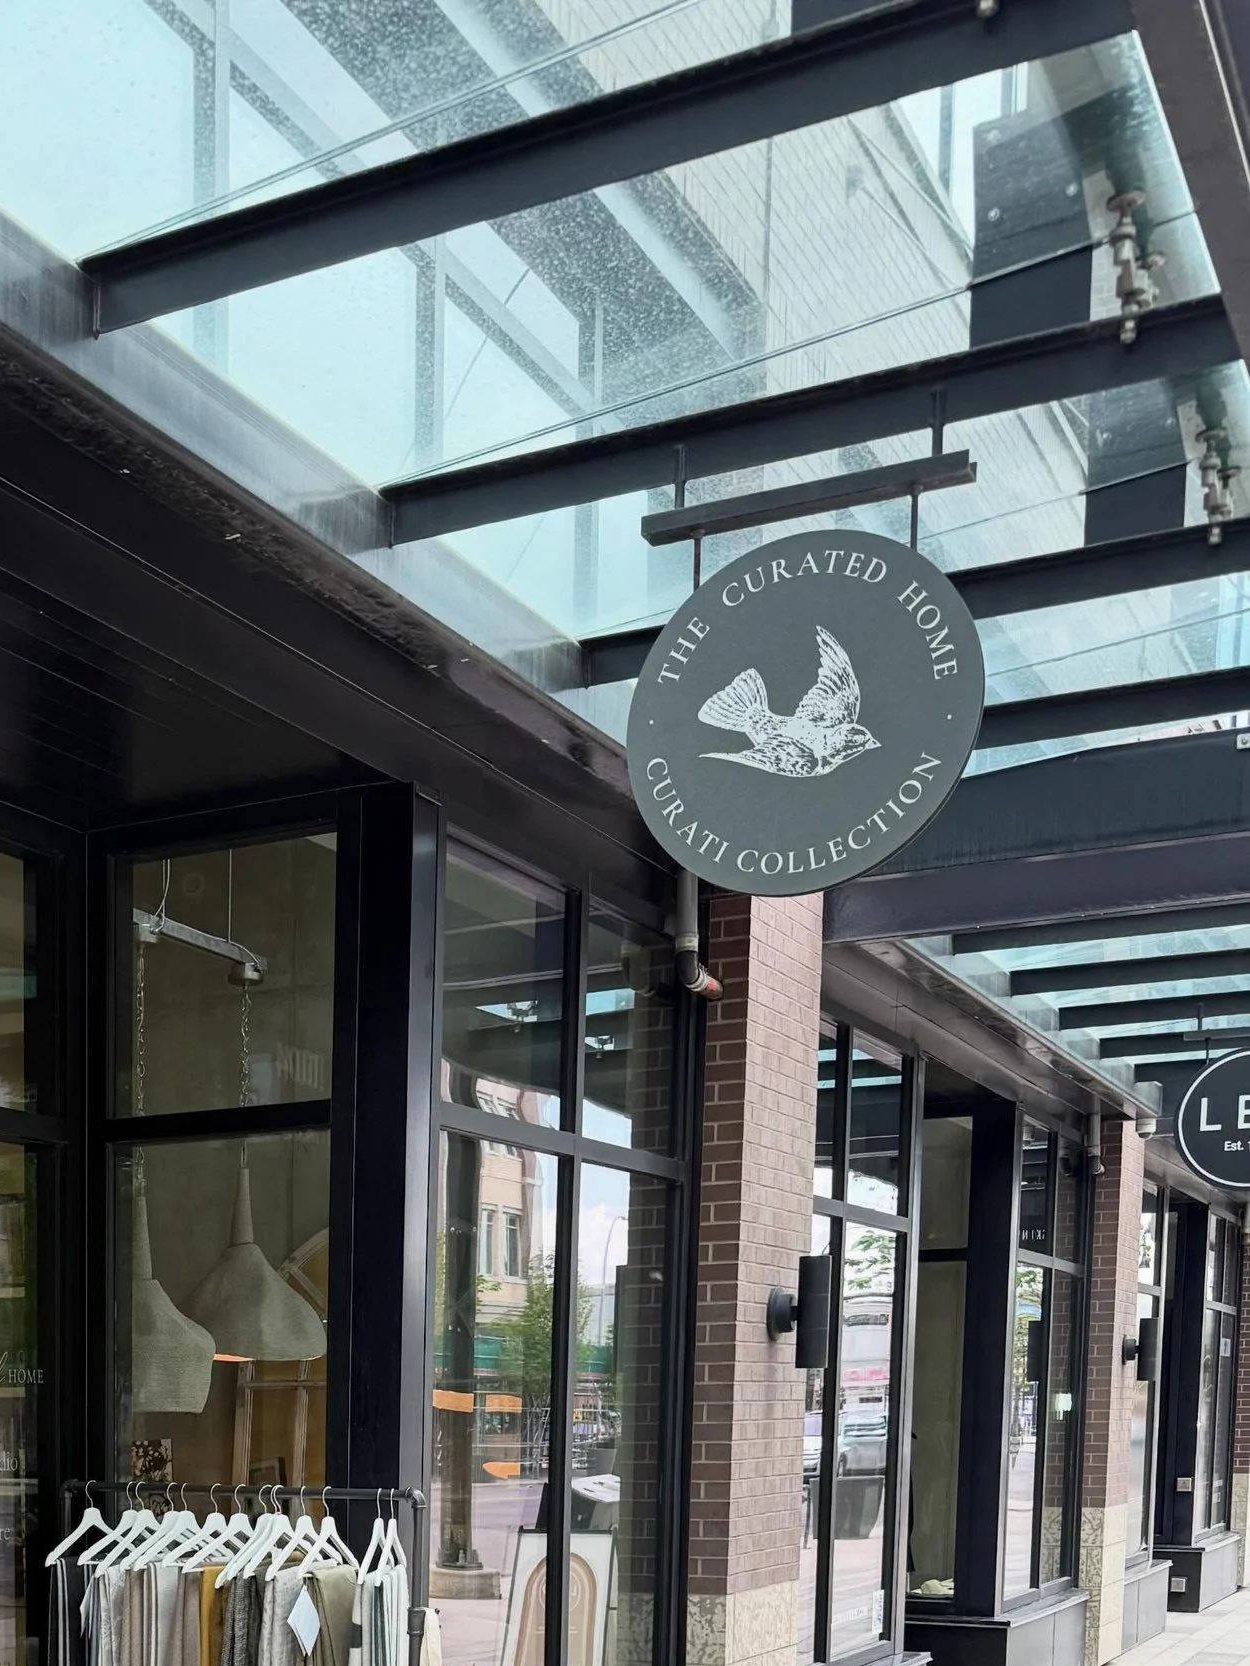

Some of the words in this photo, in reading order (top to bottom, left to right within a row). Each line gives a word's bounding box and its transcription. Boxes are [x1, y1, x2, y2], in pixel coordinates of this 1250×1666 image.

[657, 616, 711, 685] THE
[722, 550, 887, 607] CURATED
[896, 580, 958, 680] HOME
[646, 757, 730, 864] CURATI
[736, 752, 942, 875] COLLECTION
[8, 1369, 44, 1384] HOME
